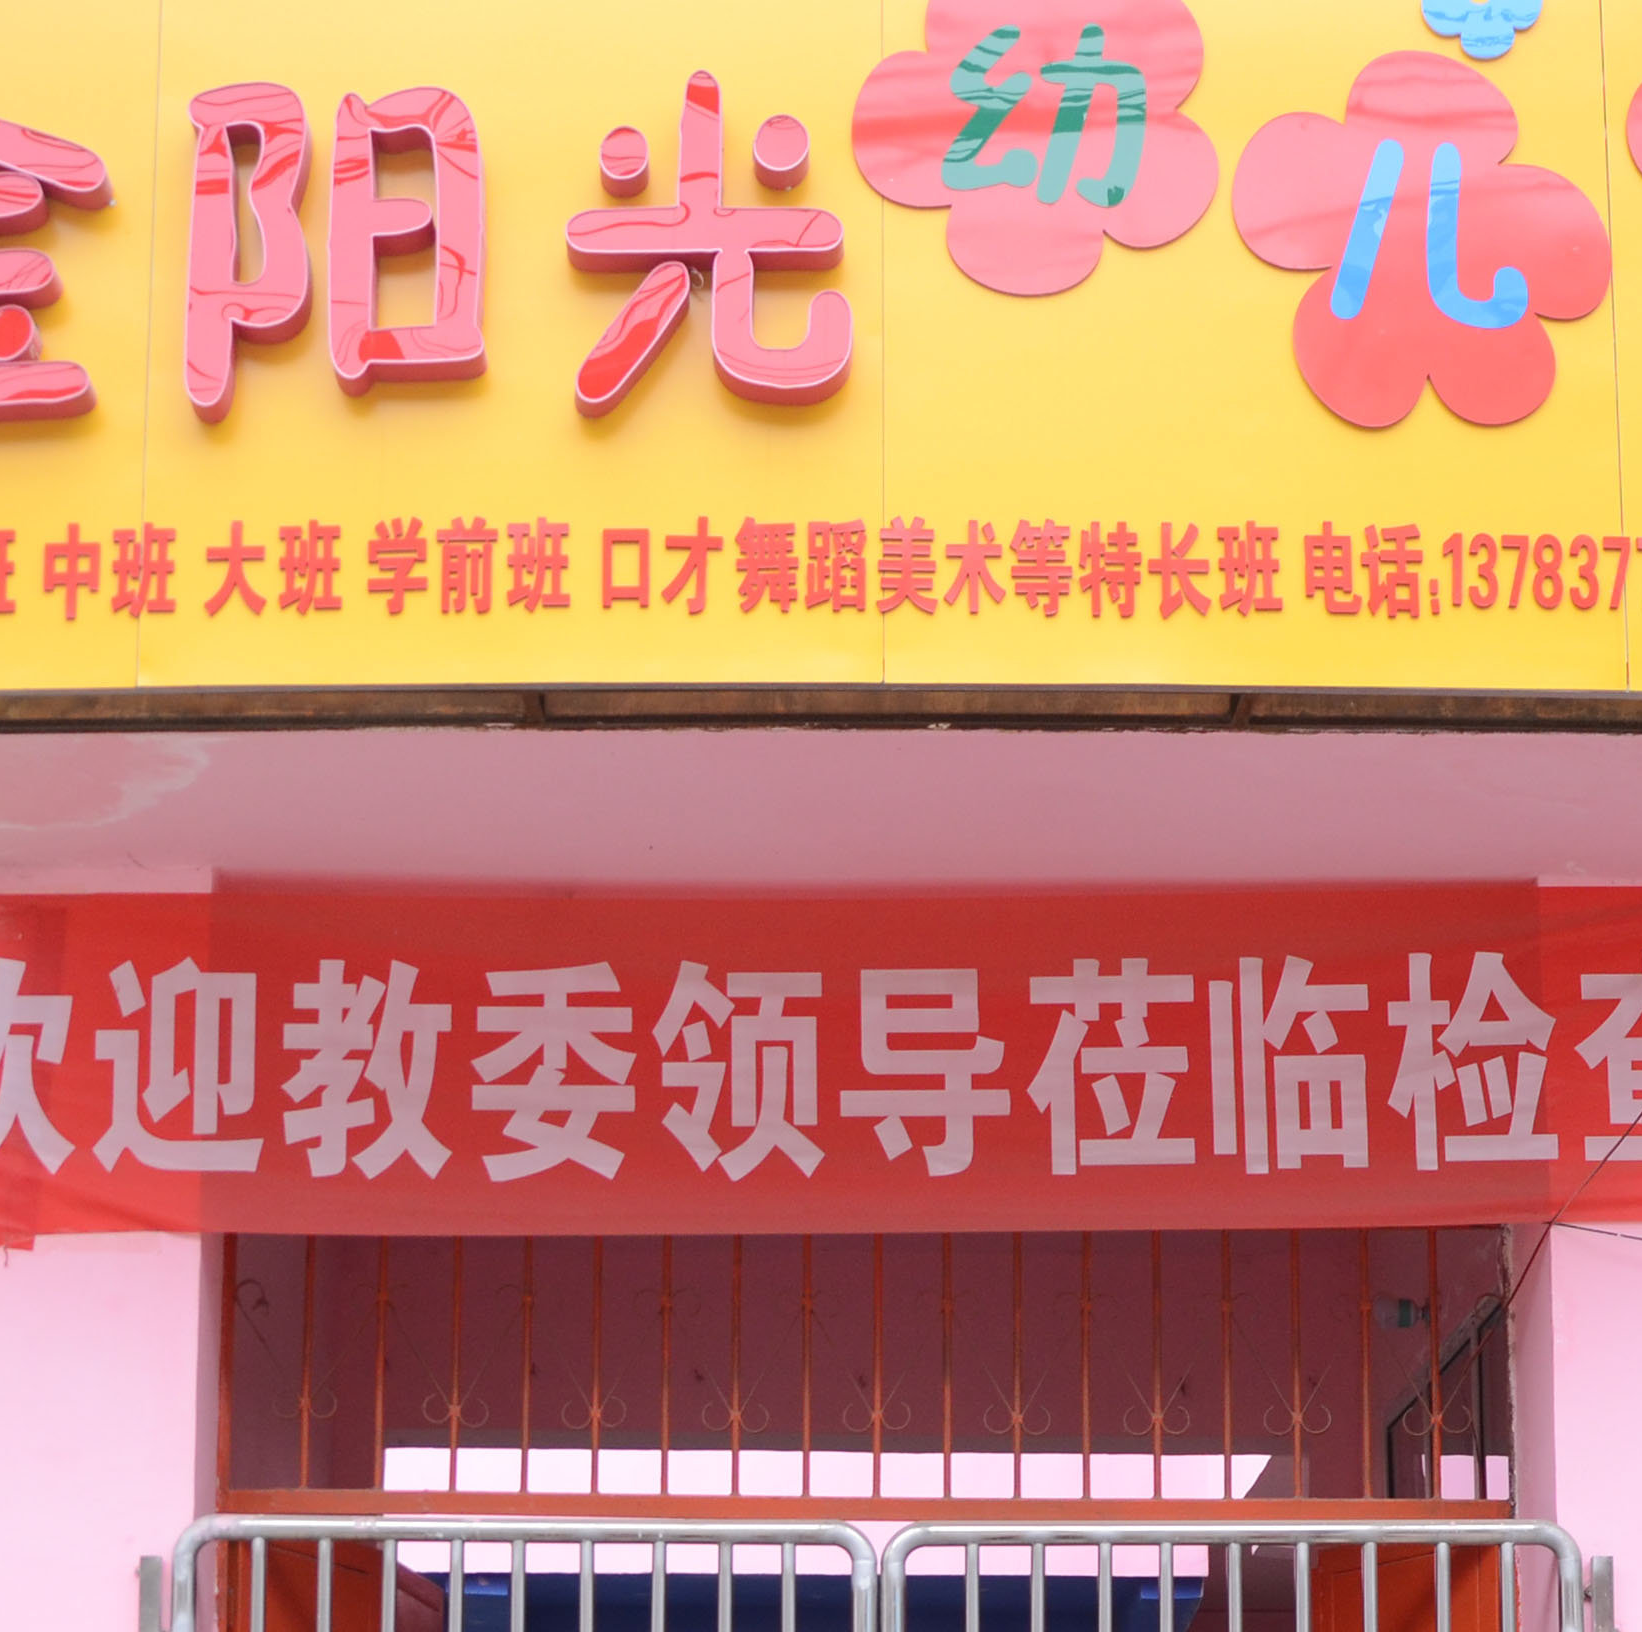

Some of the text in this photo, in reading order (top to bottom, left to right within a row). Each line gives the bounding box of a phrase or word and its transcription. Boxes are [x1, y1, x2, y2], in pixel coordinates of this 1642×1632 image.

[43, 522, 177, 621] 中班
[205, 519, 343, 617] 大班
[367, 516, 571, 615] 学前班
[602, 515, 1281, 619] 口才舞蹈美术等特长班
